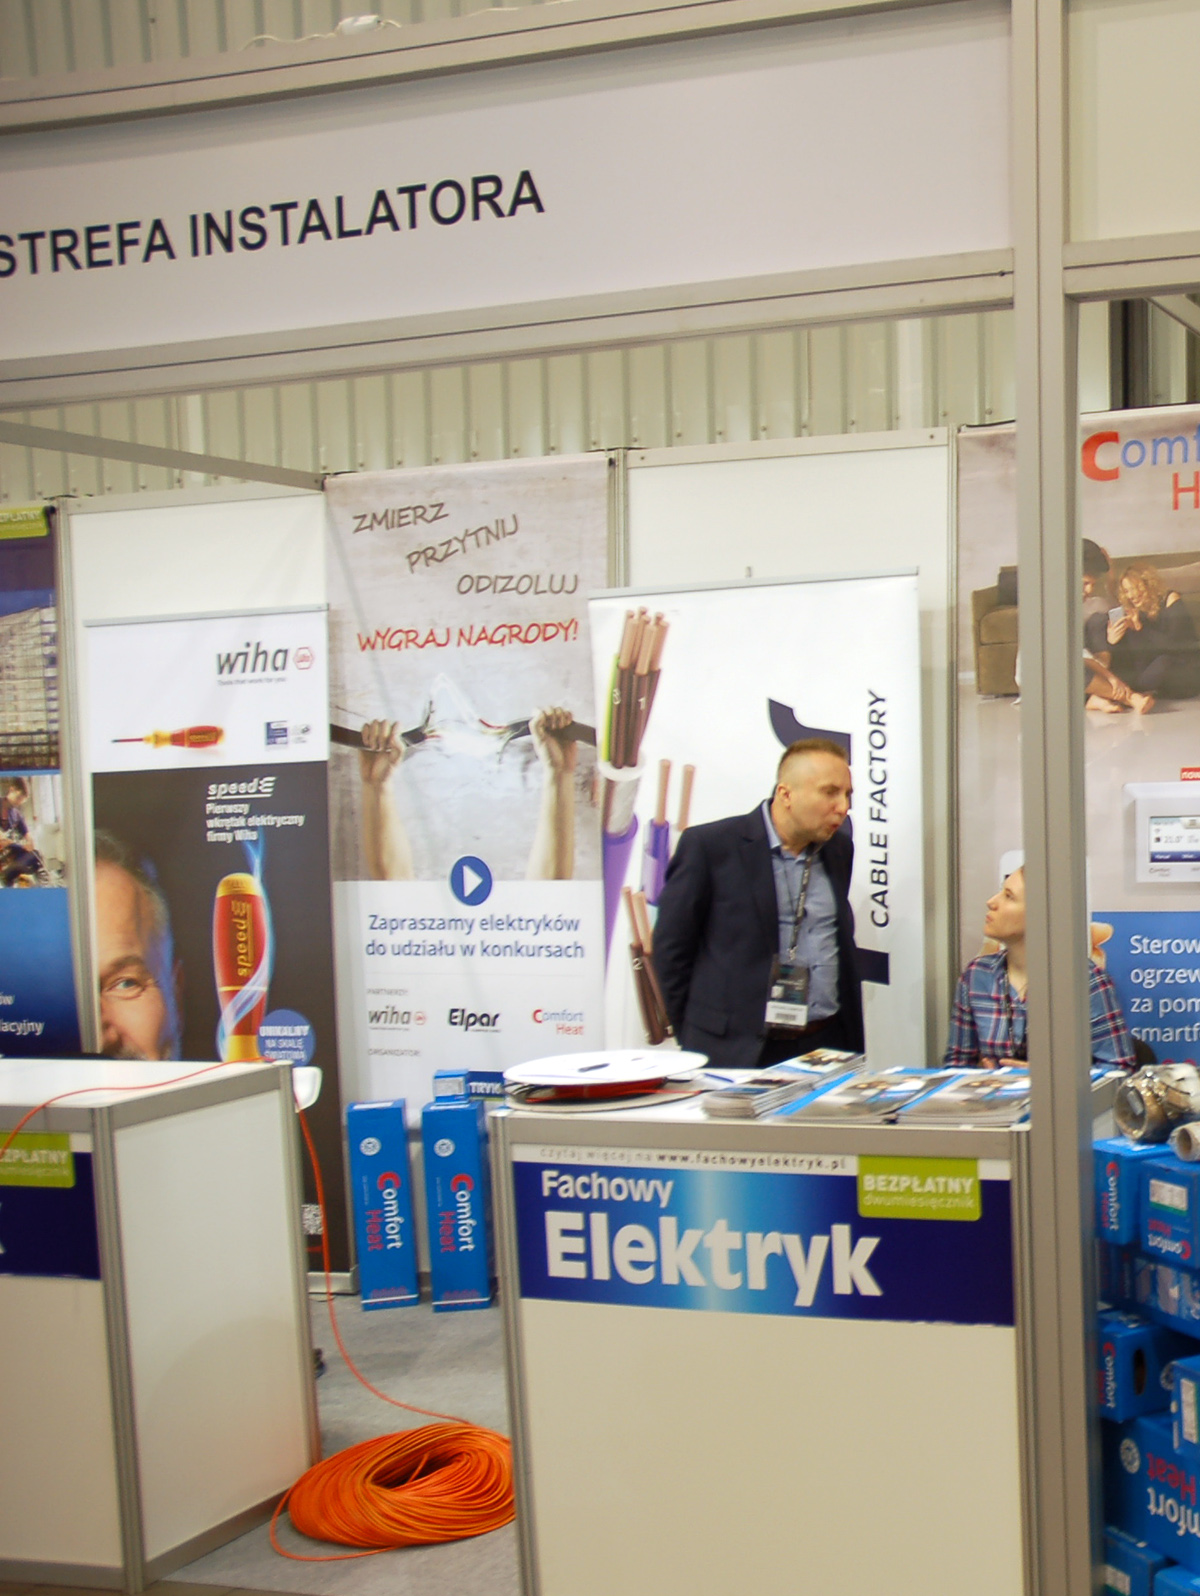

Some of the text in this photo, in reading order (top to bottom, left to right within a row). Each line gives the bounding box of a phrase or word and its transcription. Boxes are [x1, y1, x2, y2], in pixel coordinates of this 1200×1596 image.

[0, 170, 545, 279] STREFA INSTALATORA
[352, 502, 449, 534] ZMIERZ
[405, 513, 519, 574] PRZYTNIJ
[457, 574, 579, 595] ODIZOLUJ
[357, 617, 579, 651] WYGRAJ NAGRODY!
[217, 641, 289, 675] wiha
[247, 814, 305, 827] elektryczny
[868, 689, 890, 928] CABLE FACTORY
[368, 914, 581, 936] Zapraszamy elektryków
[365, 939, 585, 958] do udziału w konkursach
[368, 1005, 412, 1025] wiha
[448, 1008, 500, 1032] Elpar
[532, 1009, 584, 1024] Comfort
[1130, 998, 1153, 1013] za
[556, 1024, 584, 1035] Heat
[541, 1169, 674, 1208] Fachowy
[863, 1174, 974, 1194] BEZPŁATNY
[1106, 1161, 1121, 1231] Comfort
[377, 1171, 405, 1250] Comfort
[451, 1173, 477, 1252] Comfort
[365, 1209, 384, 1252] Heat
[439, 1211, 456, 1253] Heat
[544, 1210, 883, 1307] Elektryk
[1146, 1452, 1197, 1507] Heat
